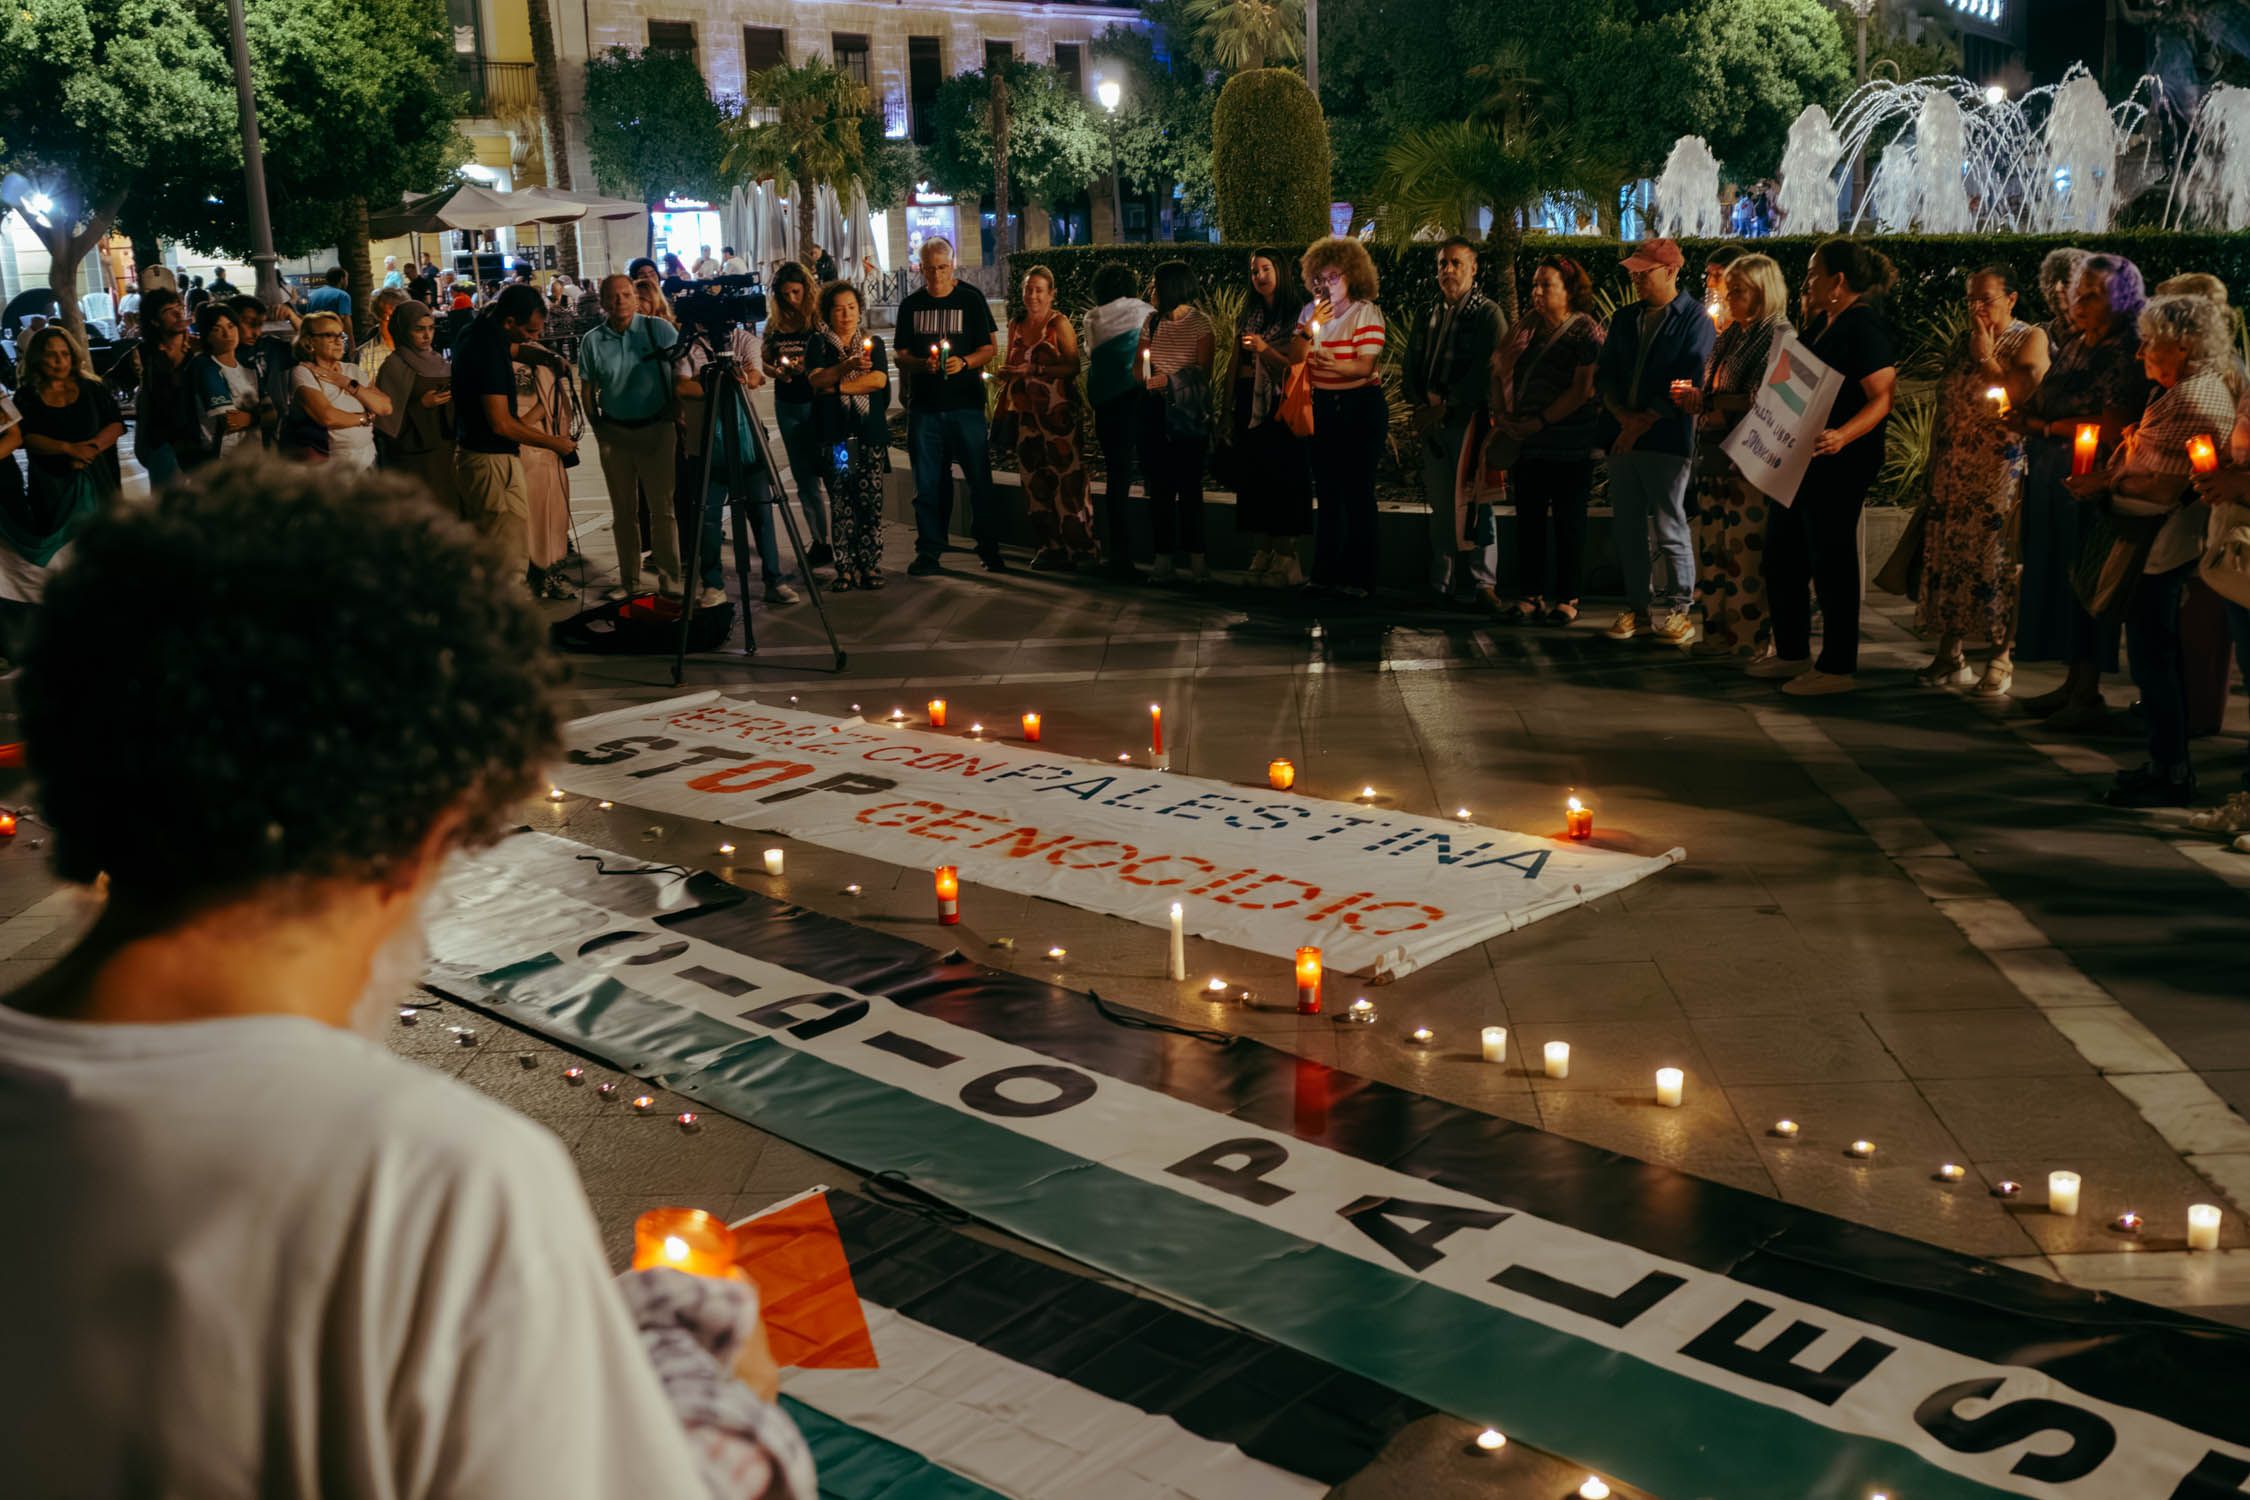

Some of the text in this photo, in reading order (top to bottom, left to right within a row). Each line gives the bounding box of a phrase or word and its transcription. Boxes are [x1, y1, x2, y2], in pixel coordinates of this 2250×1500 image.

[567, 735, 1446, 937] STOP GENOCIDIO
[863, 745, 1007, 777] CON
[984, 762, 1551, 880] PALESTINA
